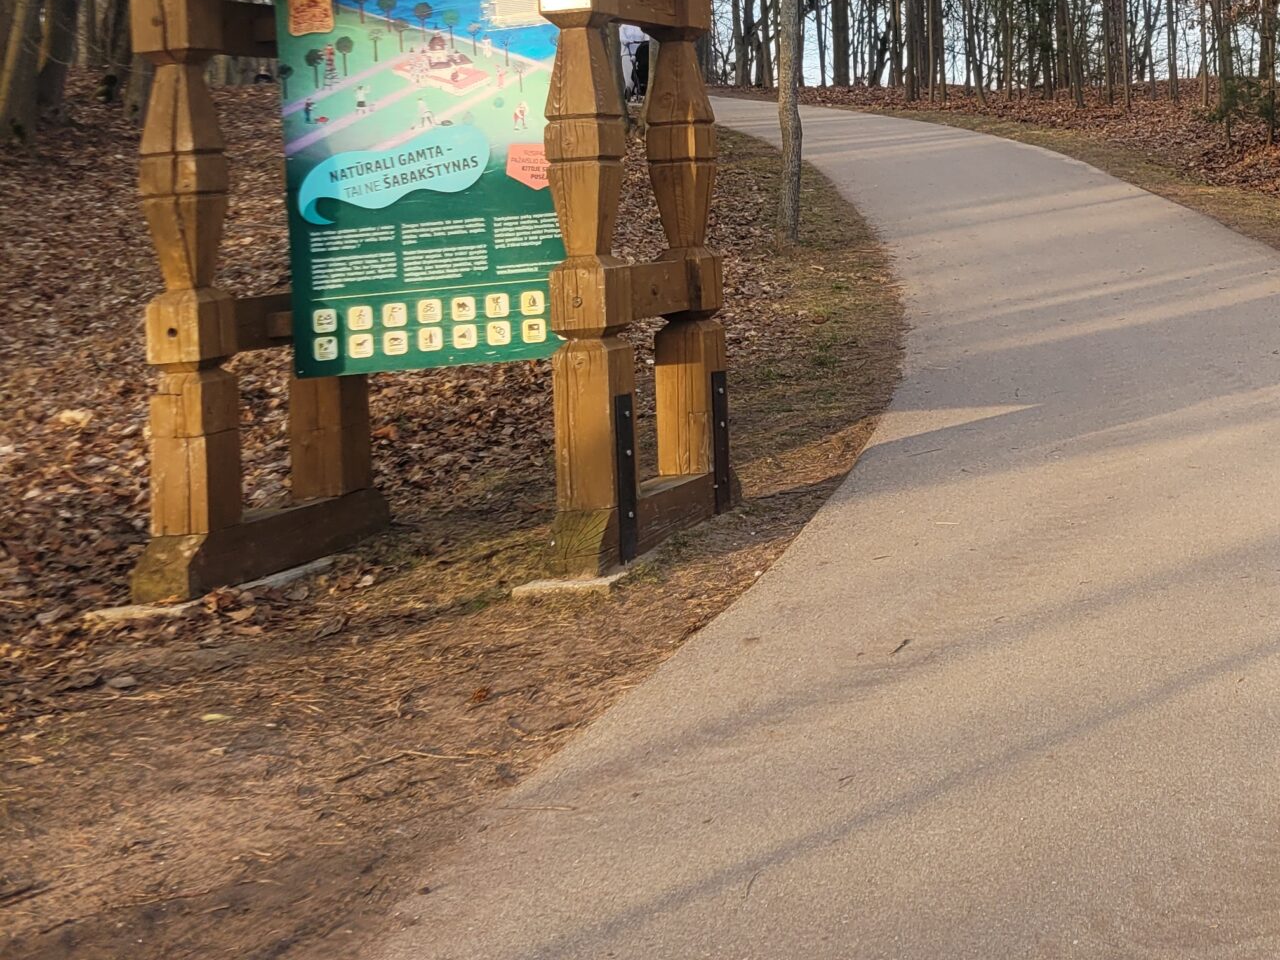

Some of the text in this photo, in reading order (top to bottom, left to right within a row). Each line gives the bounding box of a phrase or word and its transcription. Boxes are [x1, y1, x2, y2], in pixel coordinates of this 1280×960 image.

[329, 157, 395, 183] NATŪRALI
[398, 145, 444, 166] GAMTA
[344, 155, 479, 199] TAI NE ŠABAKŠTYNAS
